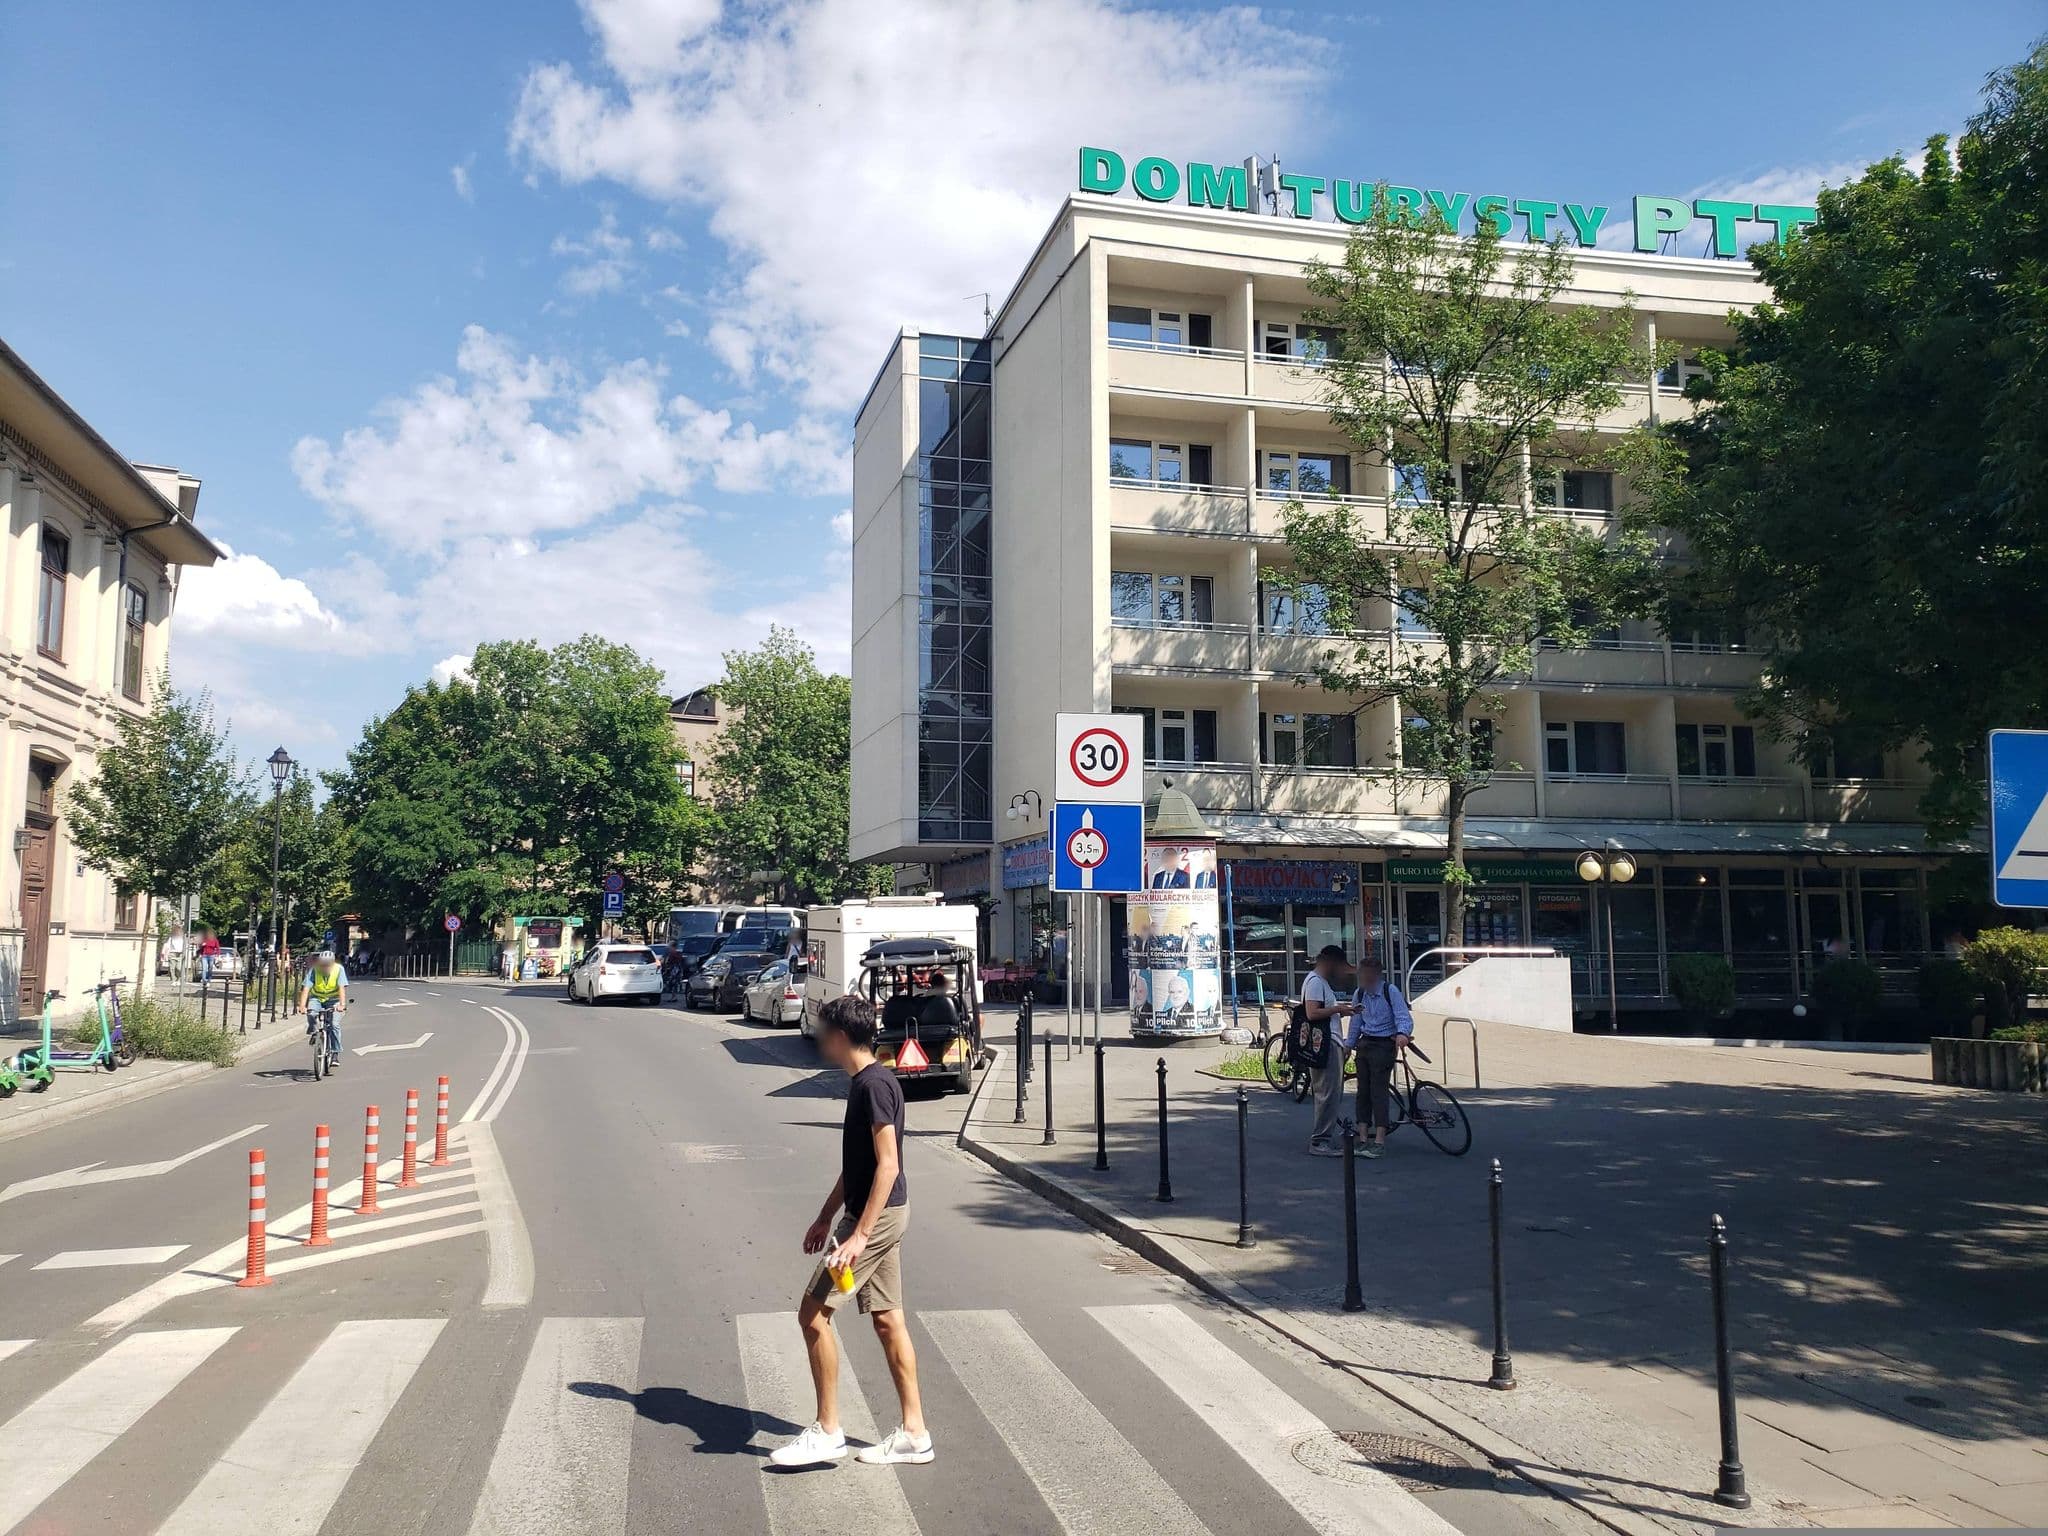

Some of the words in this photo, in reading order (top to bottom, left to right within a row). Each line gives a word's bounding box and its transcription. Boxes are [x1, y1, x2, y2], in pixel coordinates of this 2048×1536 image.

[1079, 146, 1249, 212] DOM
[1280, 172, 1608, 248] TURYSTY
[1633, 195, 1818, 259] PTT
[1080, 743, 1118, 771] 30
[1181, 847, 1189, 861] 2
[1234, 866, 1331, 889] KRAKOWIACY
[1393, 867, 1421, 876] BIURO
[607, 893, 619, 908] P
[1145, 1018, 1153, 1027] 10
[1186, 1019, 1195, 1028] 10
